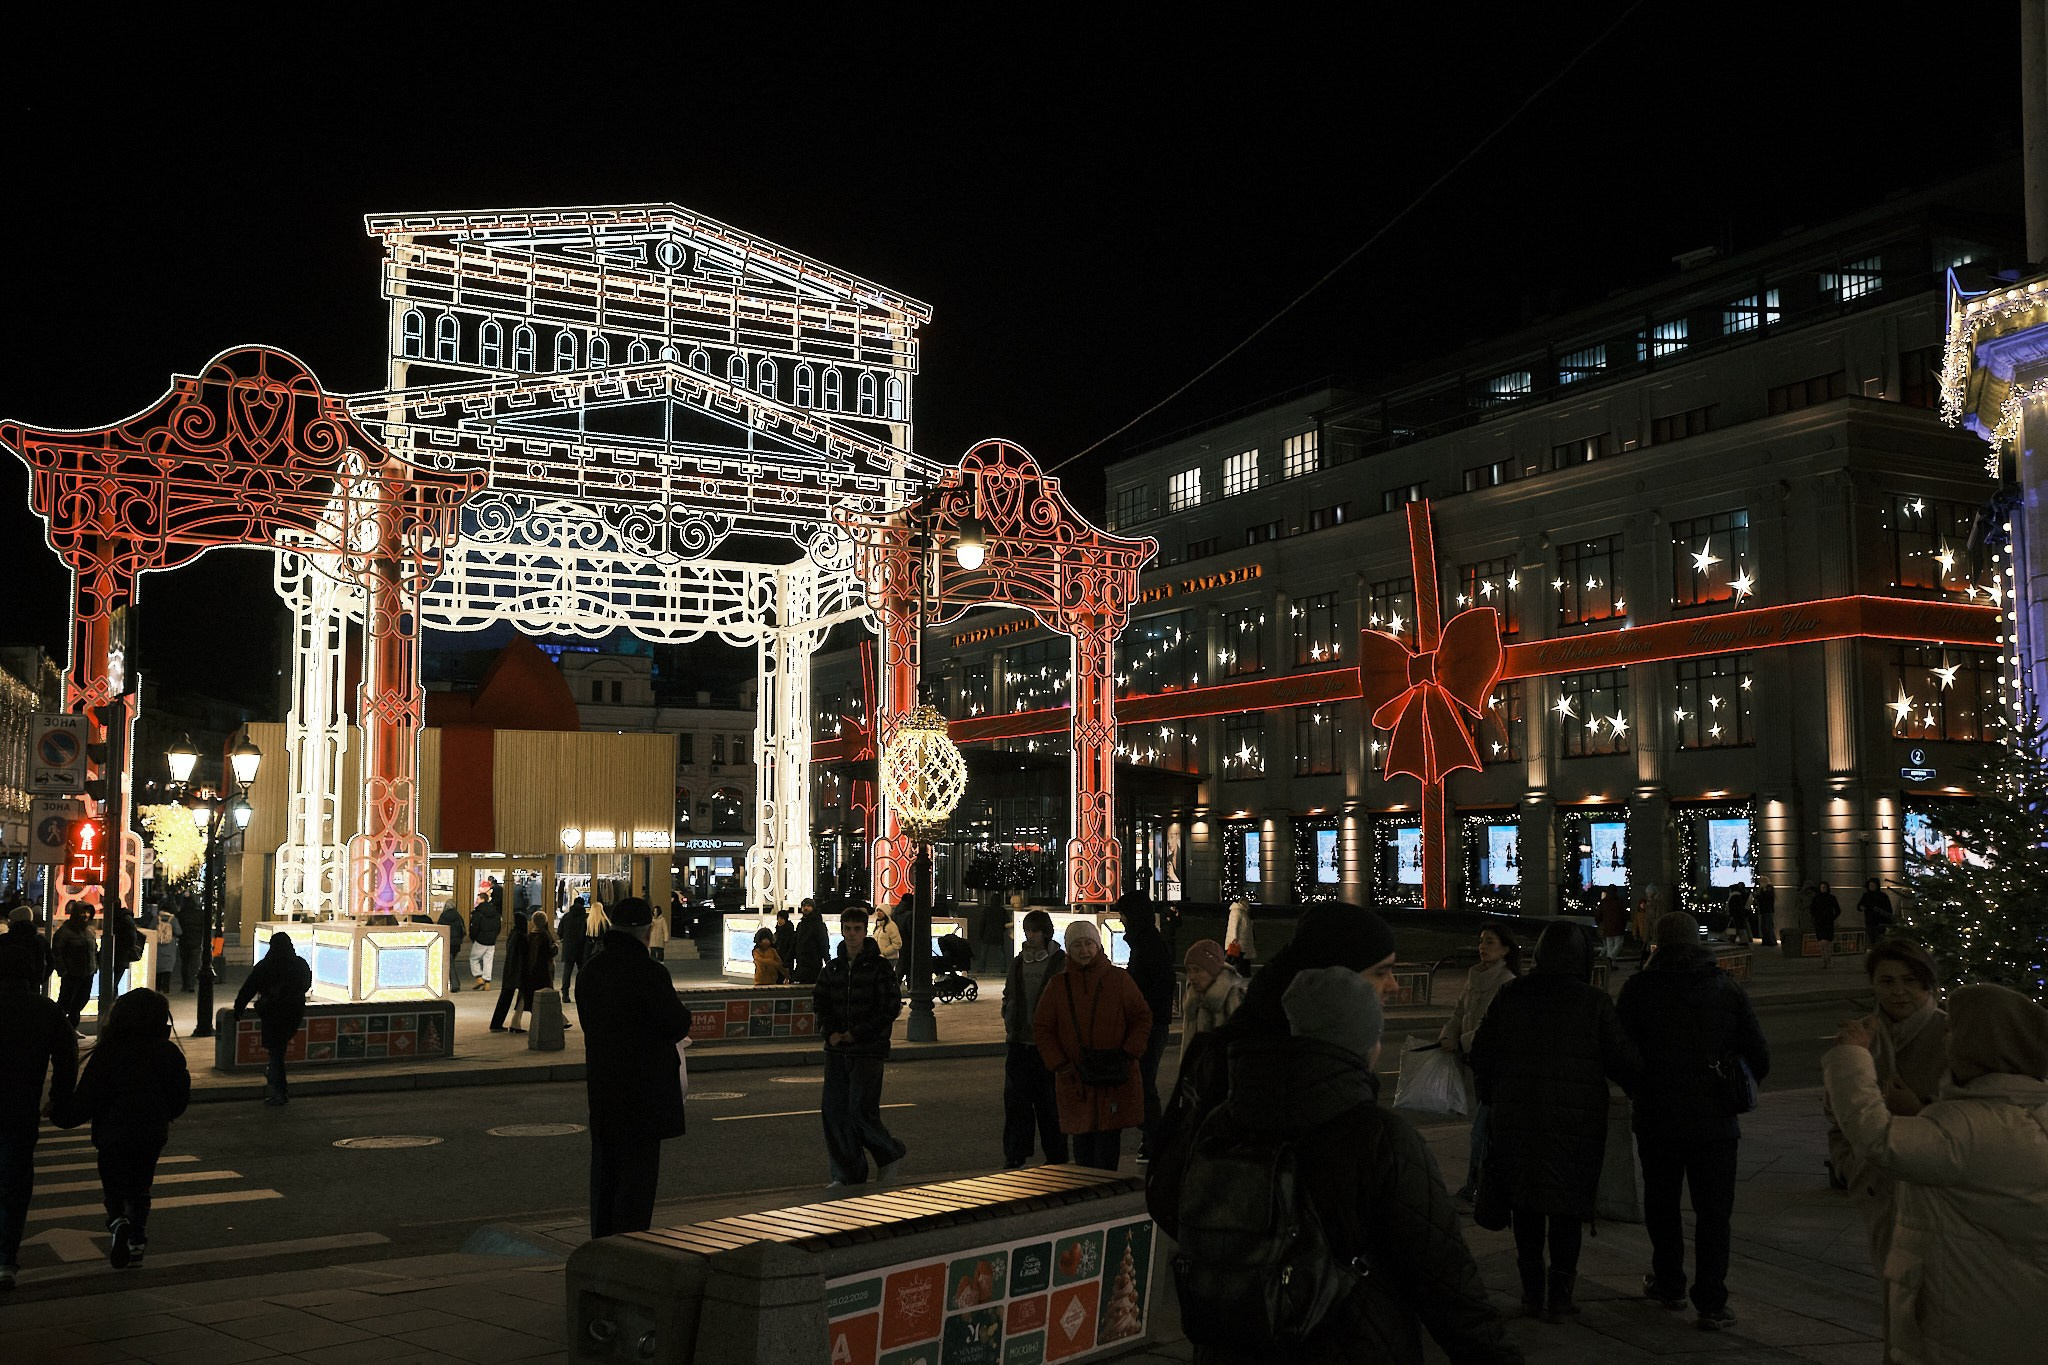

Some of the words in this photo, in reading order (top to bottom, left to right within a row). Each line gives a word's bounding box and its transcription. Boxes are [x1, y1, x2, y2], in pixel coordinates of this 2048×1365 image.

[1181, 564, 1261, 594] МАГАЗИН
[1687, 621, 1739, 650] Happy
[1737, 614, 1774, 640] New
[1778, 609, 1823, 642] Year
[44, 717, 77, 729] ЗОНА
[42, 802, 71, 812] ЗОНА
[70, 853, 105, 884] 24
[690, 1014, 716, 1025] ИМА
[827, 1290, 869, 1308] 28.02.2025
